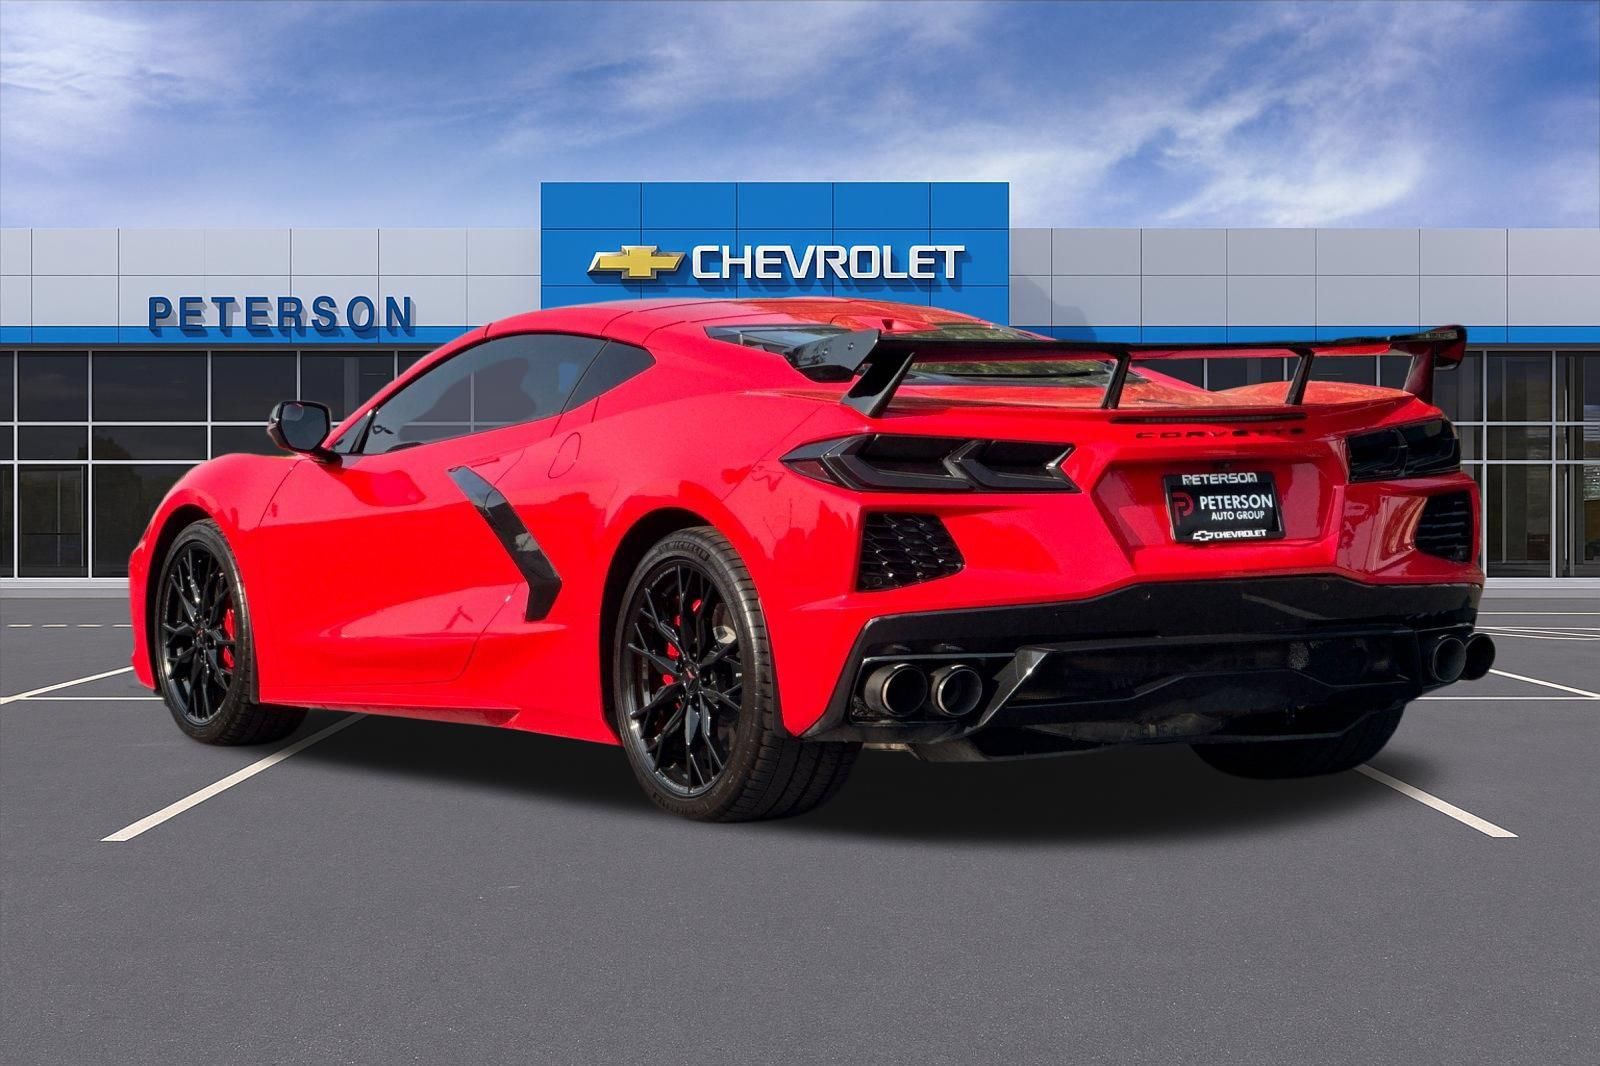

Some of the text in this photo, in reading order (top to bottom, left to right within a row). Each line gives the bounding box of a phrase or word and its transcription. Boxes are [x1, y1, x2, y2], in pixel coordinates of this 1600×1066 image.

[692, 245, 965, 279] CHEVROLET
[148, 296, 412, 332] PETERSON
[1181, 472, 1258, 486] PETERSON
[1199, 493, 1273, 510] PETERSON
[1211, 511, 1265, 521] AUTO GROUP
[1214, 529, 1267, 539] CHEVROLET
